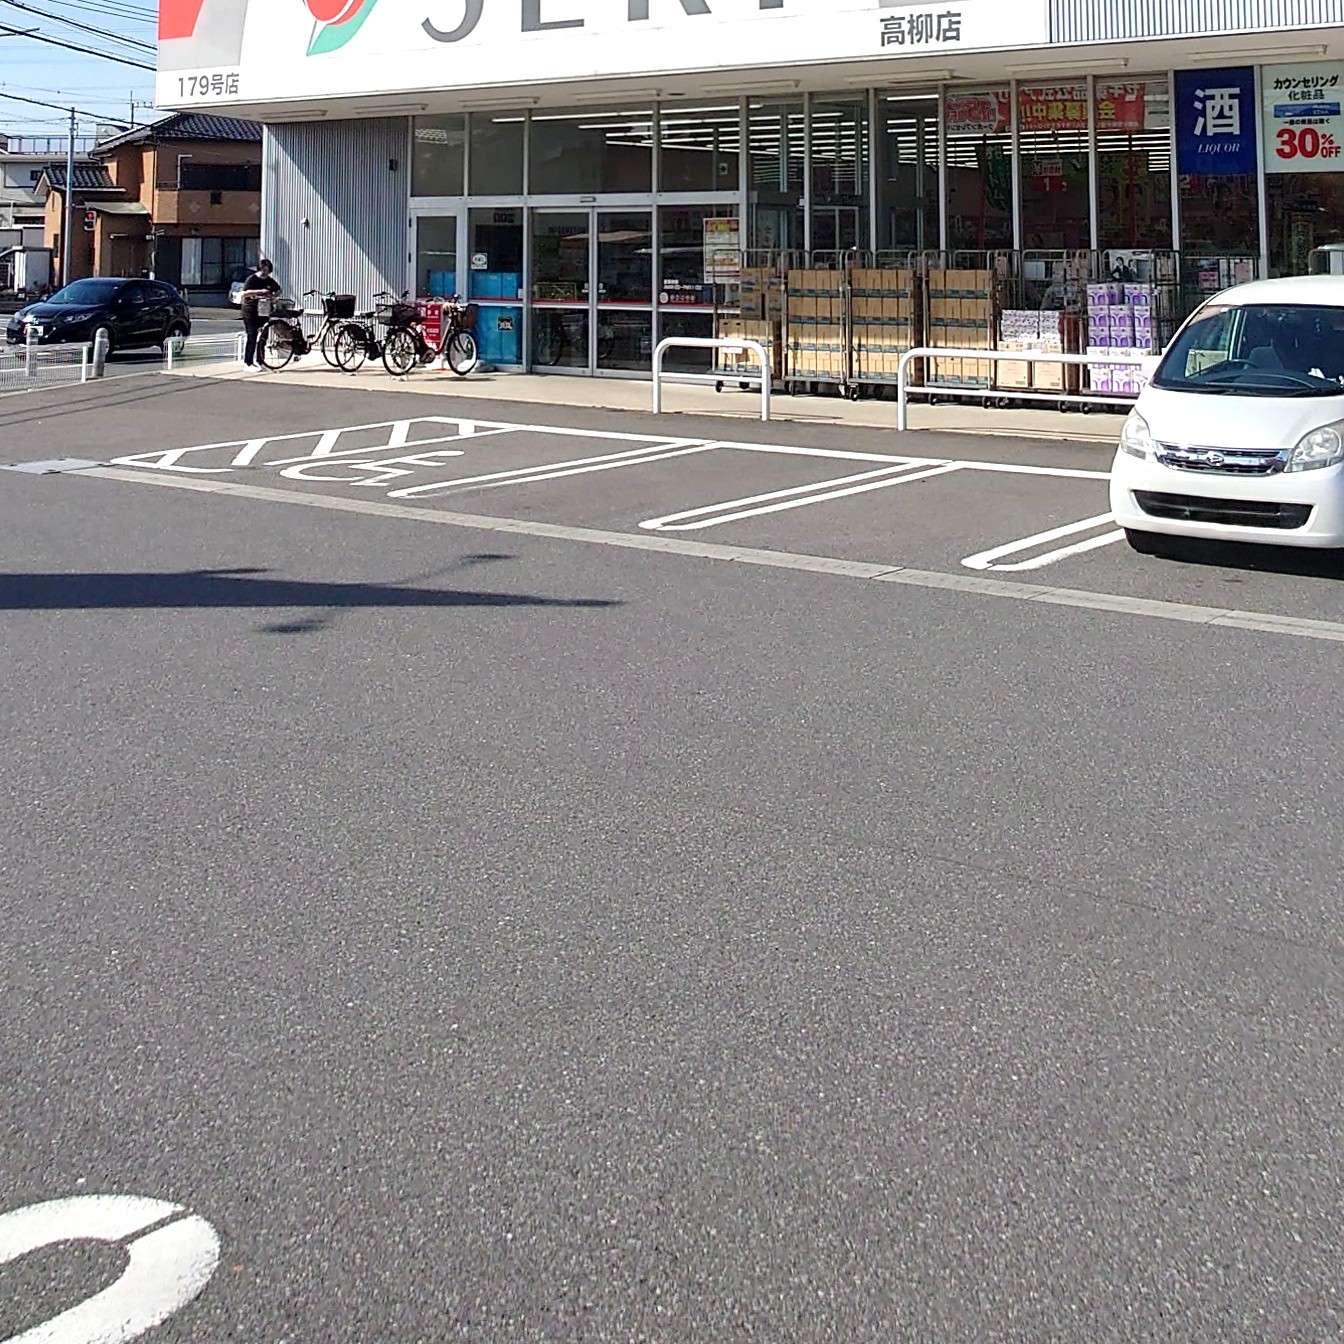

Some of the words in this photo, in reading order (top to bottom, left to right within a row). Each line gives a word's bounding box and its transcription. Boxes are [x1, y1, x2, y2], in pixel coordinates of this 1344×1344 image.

[879, 11, 962, 47] 高柳店
[178, 72, 240, 97] 179号店
[1273, 74, 1339, 90] カウンセリング
[1288, 89, 1325, 101] 化粧品
[1193, 87, 1241, 137] 酒
[1197, 143, 1241, 155] LIQUOR
[1321, 146, 1341, 158] OFF
